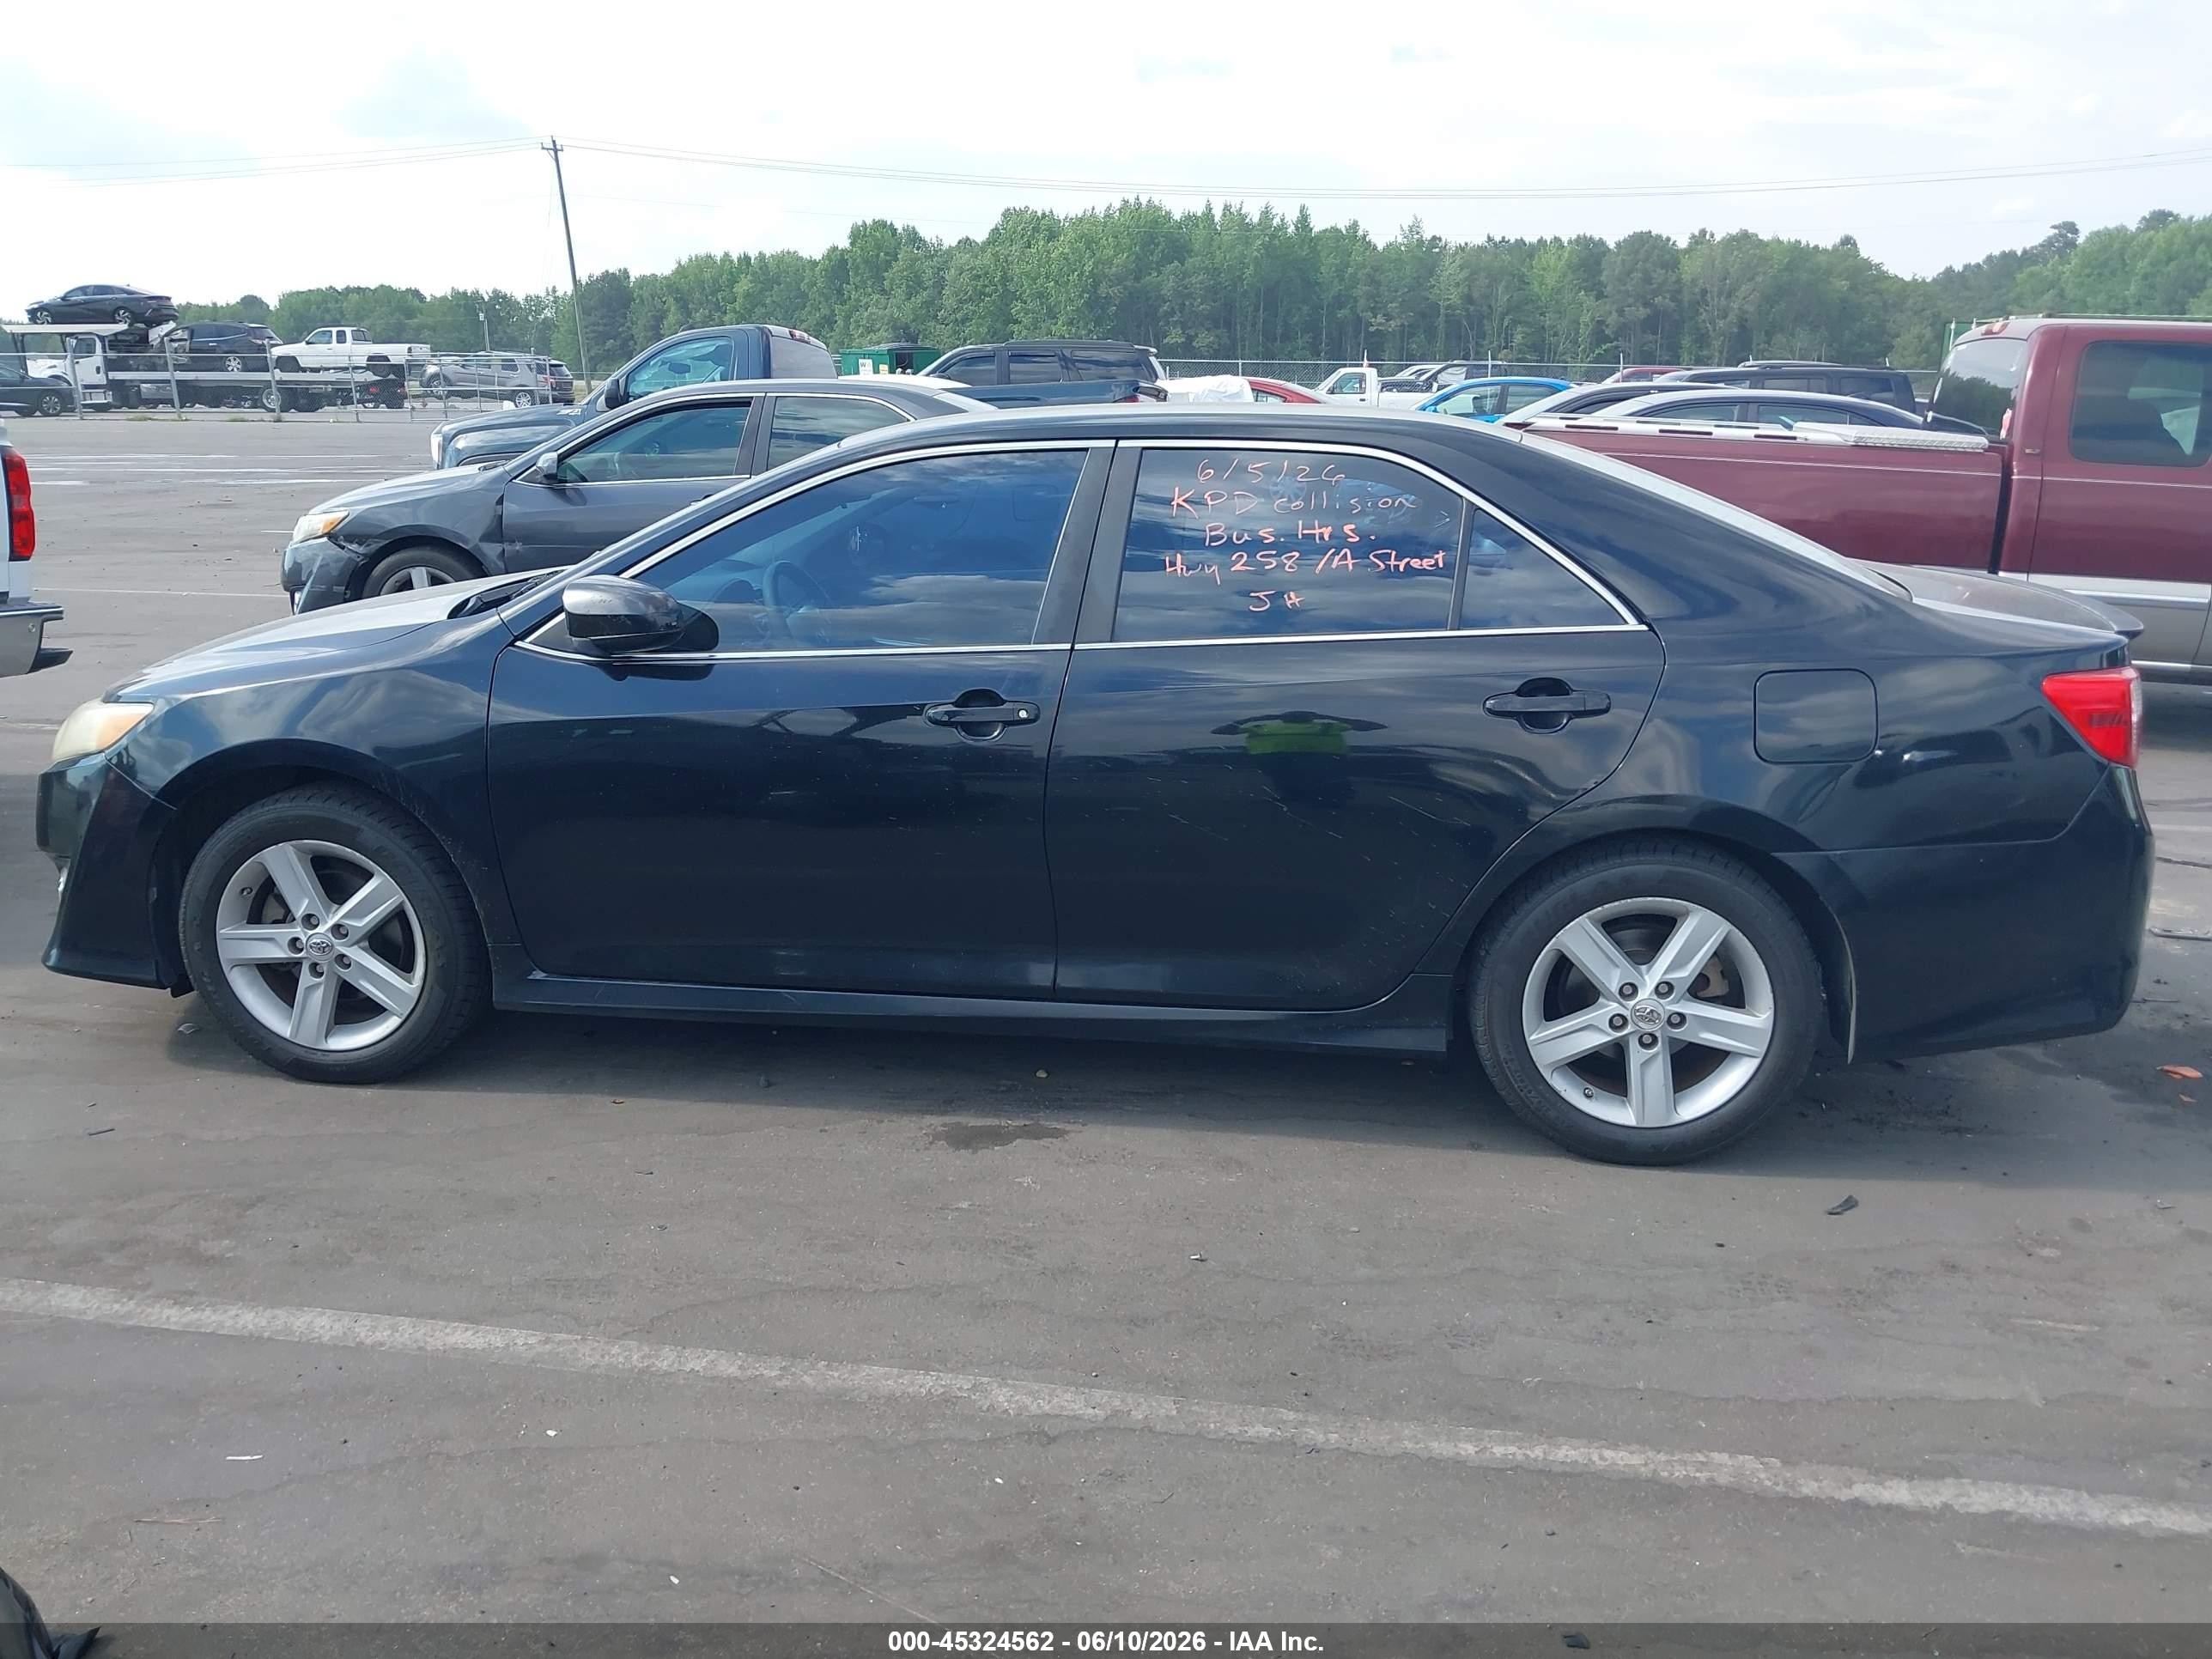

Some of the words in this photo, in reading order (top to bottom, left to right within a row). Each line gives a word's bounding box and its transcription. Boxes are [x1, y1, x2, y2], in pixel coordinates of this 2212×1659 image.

[1197, 459, 1346, 486] 6/5/26
[1170, 486, 1258, 520] KPD
[1273, 490, 1418, 515] collision
[1204, 522, 1285, 548] Bus.
[1297, 520, 1376, 544] Hrs.
[1164, 552, 1221, 586] Hwy
[1367, 550, 1447, 574] Street
